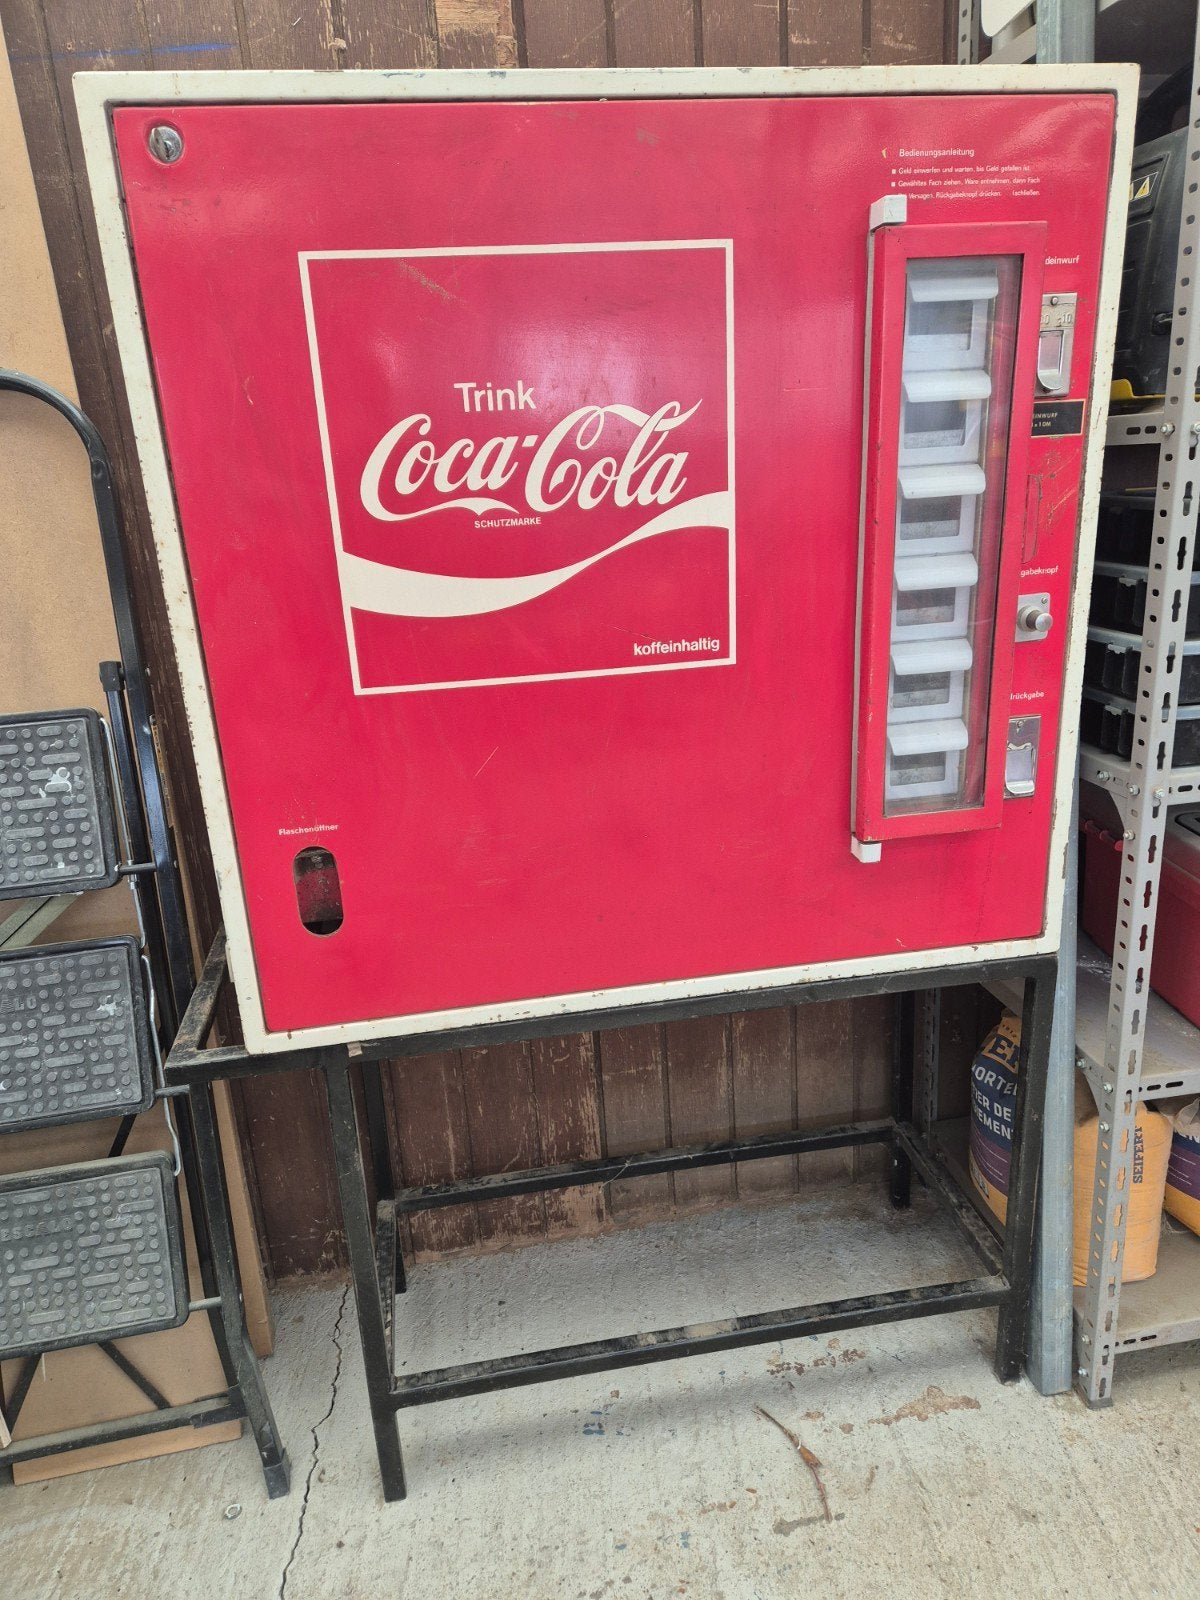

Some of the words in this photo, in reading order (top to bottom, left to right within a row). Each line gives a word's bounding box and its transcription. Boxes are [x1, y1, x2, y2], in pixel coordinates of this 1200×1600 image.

[899, 148, 975, 158] Bedienungsanleitung
[898, 167, 912, 175] Geld
[942, 165, 954, 173] und
[986, 164, 1000, 172] Geld
[1001, 164, 1022, 173] gefallen
[1027, 176, 1041, 184] Fach
[936, 191, 978, 199] Rückgabeknopf
[454, 380, 537, 412] Trink
[360, 398, 703, 522] Coca-Cola
[474, 516, 542, 529] SCHUTZMARKE
[633, 637, 720, 656] koffeinhaltig
[278, 824, 339, 836] Flaschenöffner
[993, 1102, 1012, 1122] DE
[1132, 1126, 1145, 1184] SEIFERT
